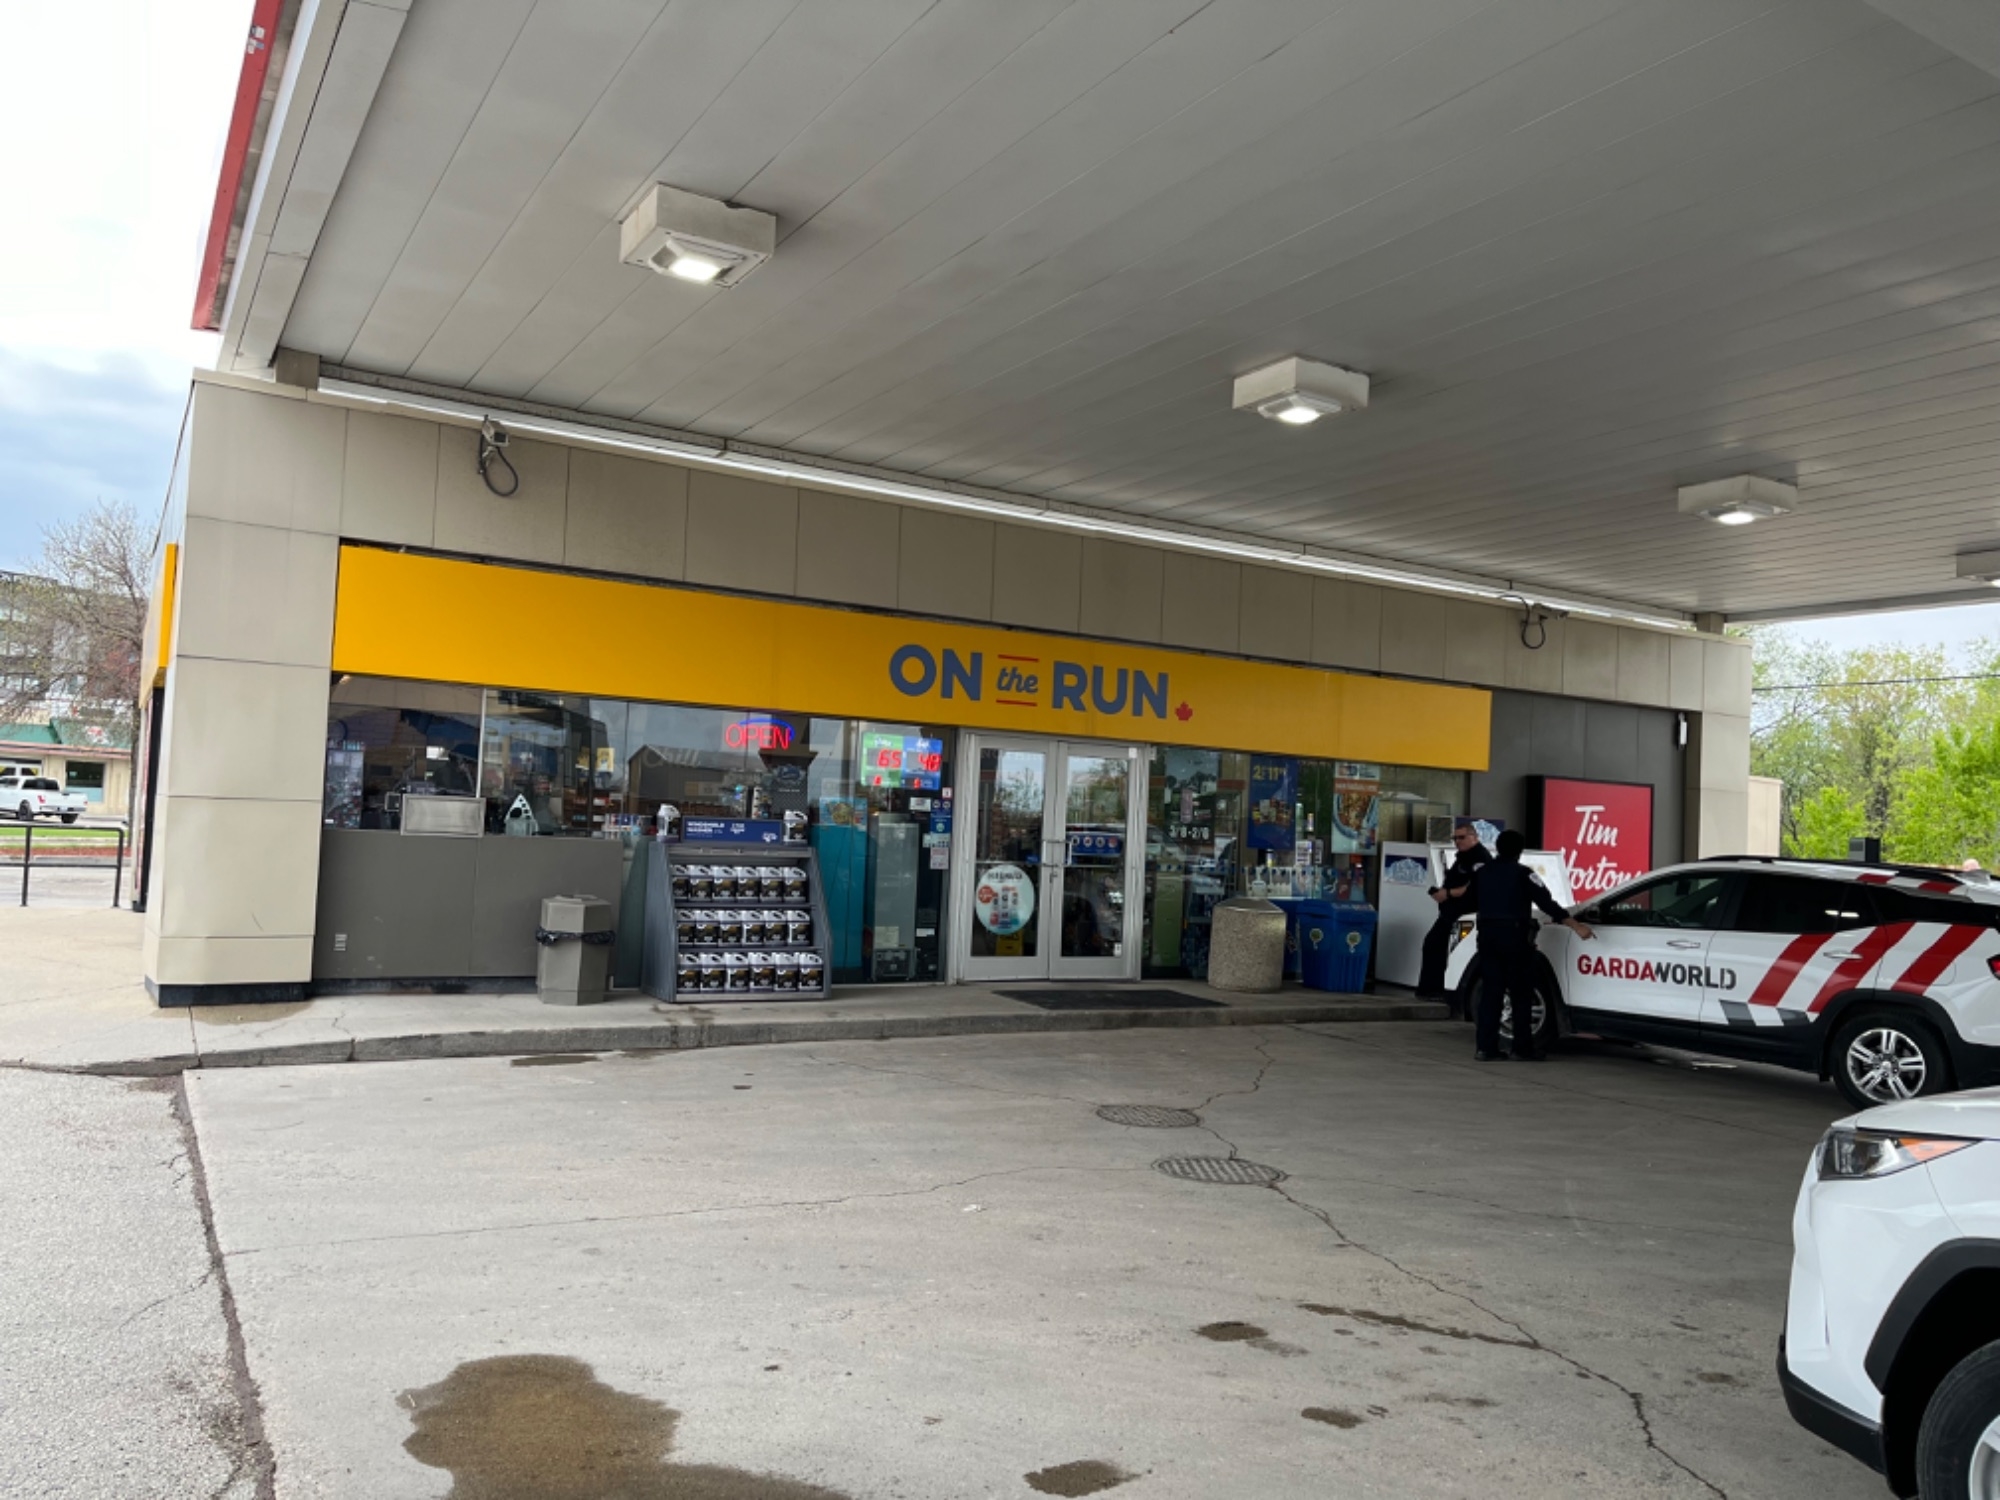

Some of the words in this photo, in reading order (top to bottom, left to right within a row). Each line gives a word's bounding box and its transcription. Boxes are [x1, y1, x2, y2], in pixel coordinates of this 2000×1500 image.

[889, 644, 983, 701] ON
[996, 667, 1038, 693] the
[1051, 660, 1169, 719] RUN
[725, 723, 791, 750] OPEN
[876, 749, 902, 770] 65
[1575, 805, 1618, 847] Tim
[1561, 846, 1642, 891] orton
[1577, 954, 1737, 990] GARDAWORLD
